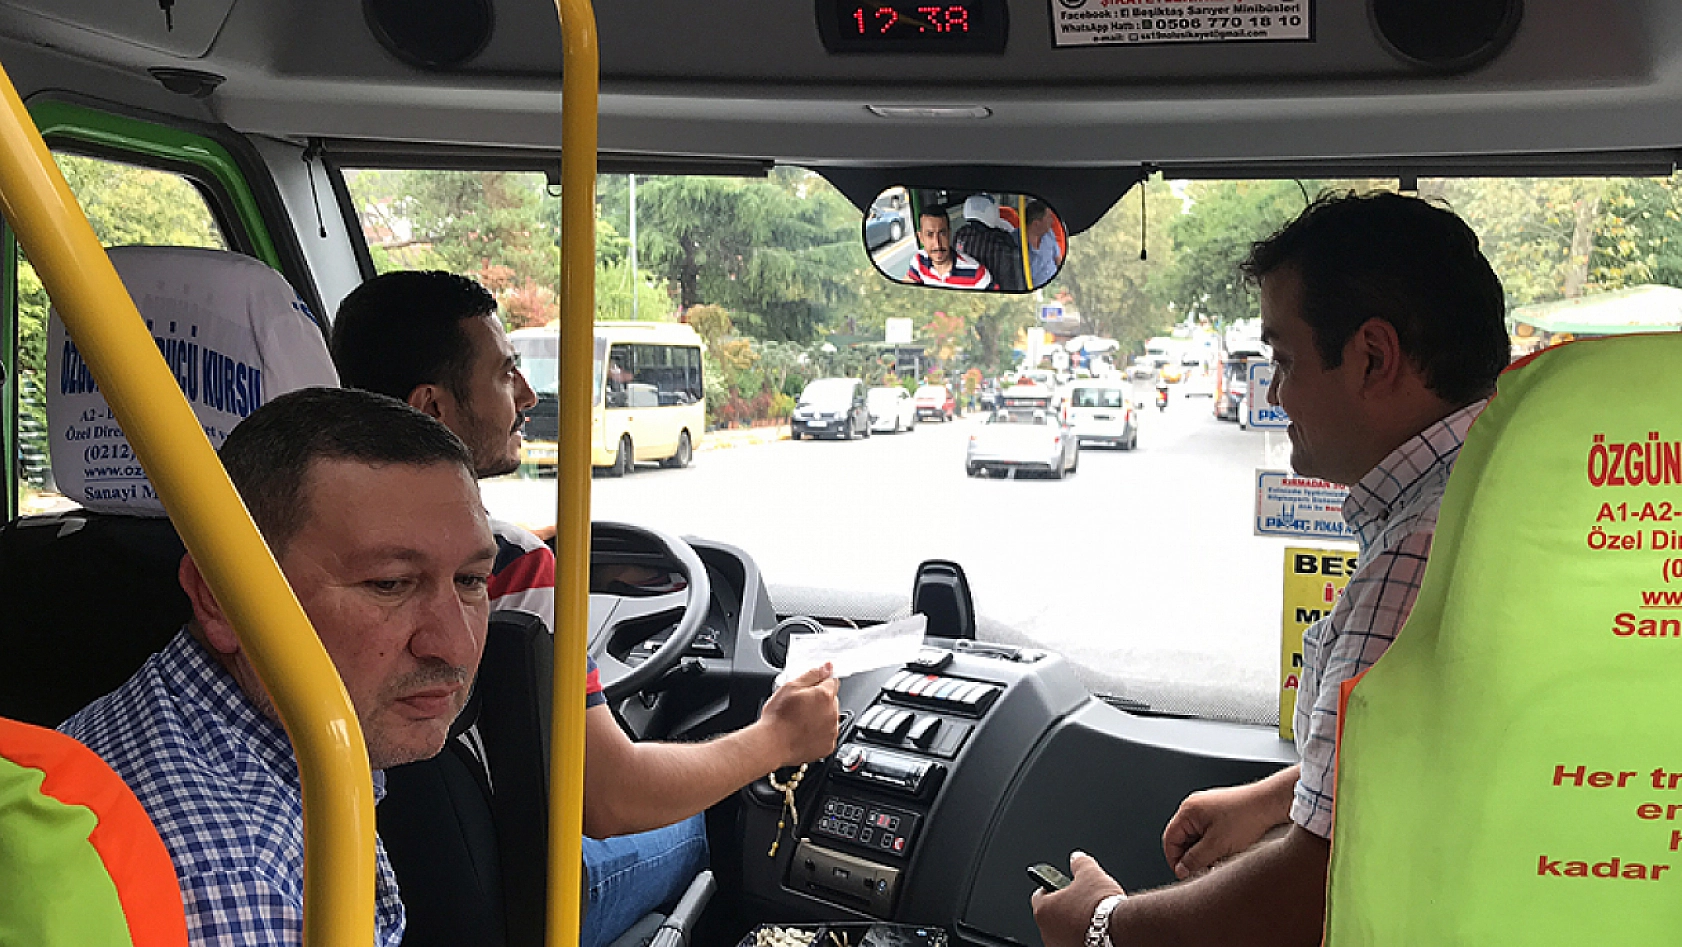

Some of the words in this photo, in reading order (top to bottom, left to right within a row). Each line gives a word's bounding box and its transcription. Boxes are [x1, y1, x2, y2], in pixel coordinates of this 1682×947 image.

[1061, 10, 1111, 20] Facebook
[1207, 17, 1242, 28] 770
[1279, 14, 1301, 26] 10
[203, 347, 261, 418] KURSU
[65, 425, 91, 441] Özel
[1587, 432, 1682, 488] ÖZGÜN
[84, 485, 137, 501] Sanayi
[1596, 501, 1682, 523] A1-A2-
[1587, 526, 1643, 550] Özel
[1612, 612, 1681, 636] San
[1553, 765, 1638, 788] Her
[1537, 855, 1670, 881] kadar
